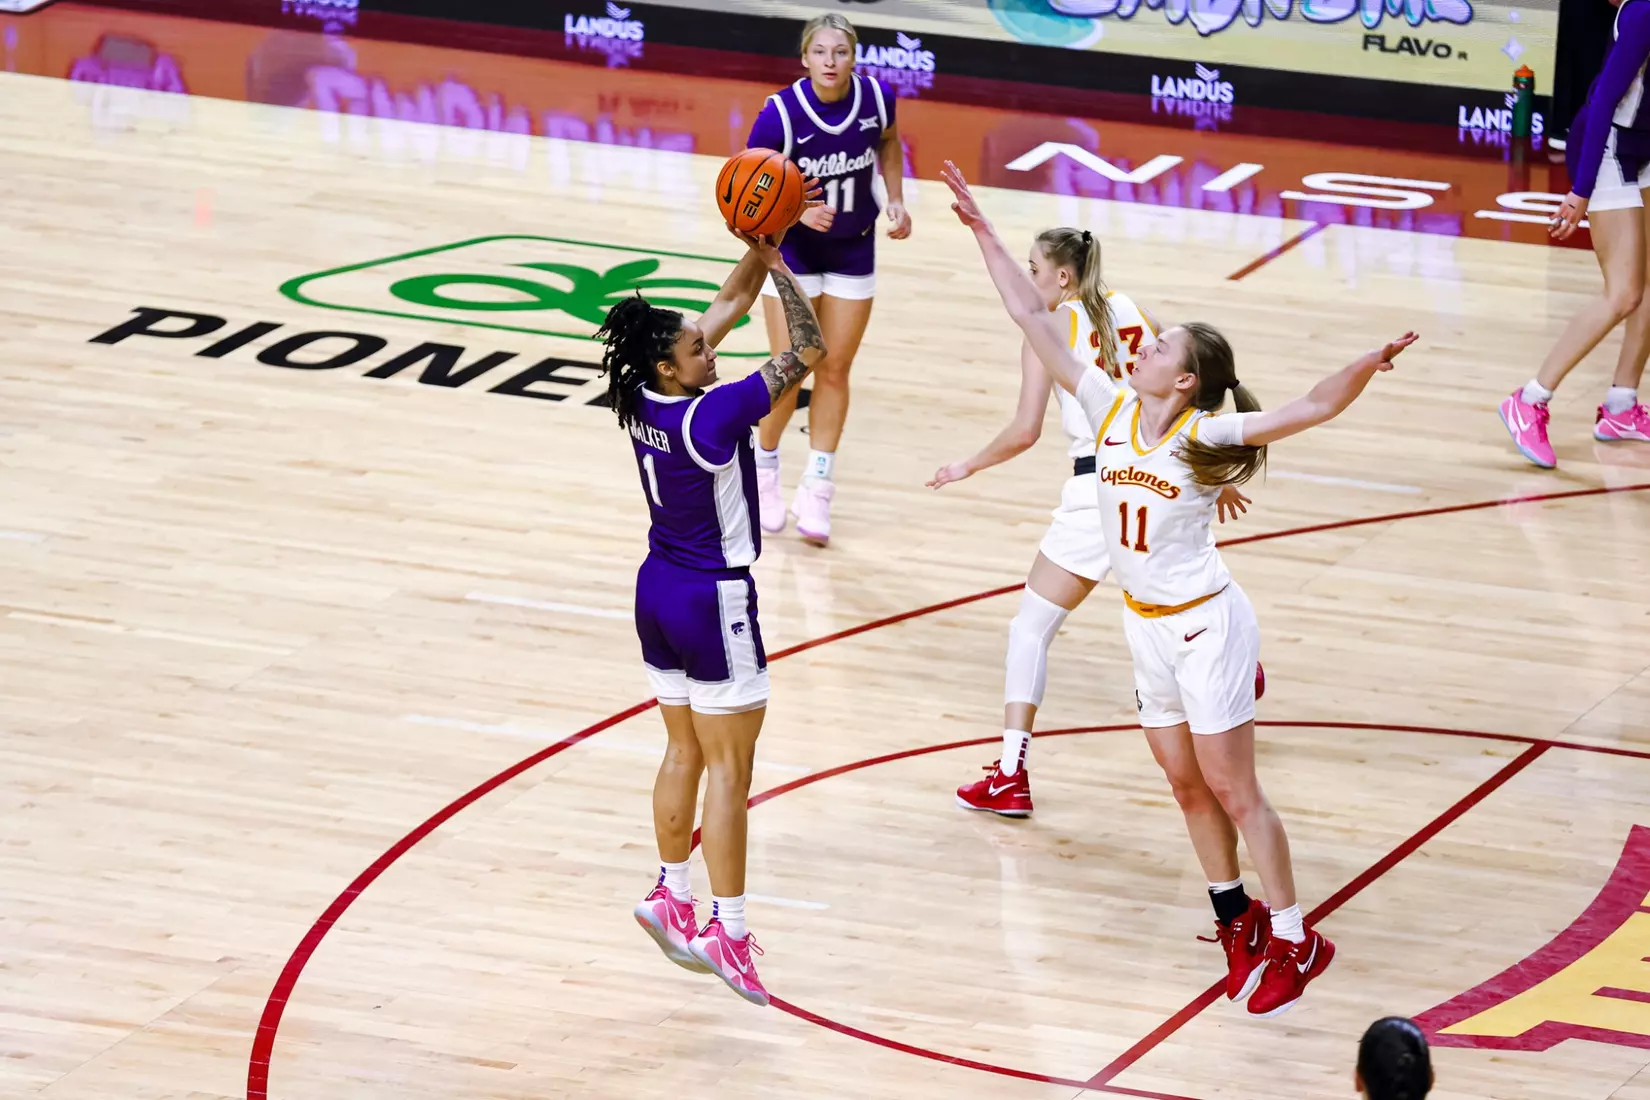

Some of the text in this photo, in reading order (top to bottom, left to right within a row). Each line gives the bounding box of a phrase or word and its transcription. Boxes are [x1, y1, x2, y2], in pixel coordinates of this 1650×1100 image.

[564, 13, 644, 41] LANDUS
[855, 43, 935, 72] LANDUS
[1151, 74, 1234, 104] LANDUS
[1458, 104, 1544, 135] LANDS
[798, 147, 876, 178] Wildcats
[742, 171, 775, 219] ELITE
[825, 177, 855, 213] 11
[629, 414, 671, 454] WALKER
[642, 452, 664, 508] 1
[1100, 465, 1182, 500] Cyclones
[1118, 501, 1150, 553] 11
